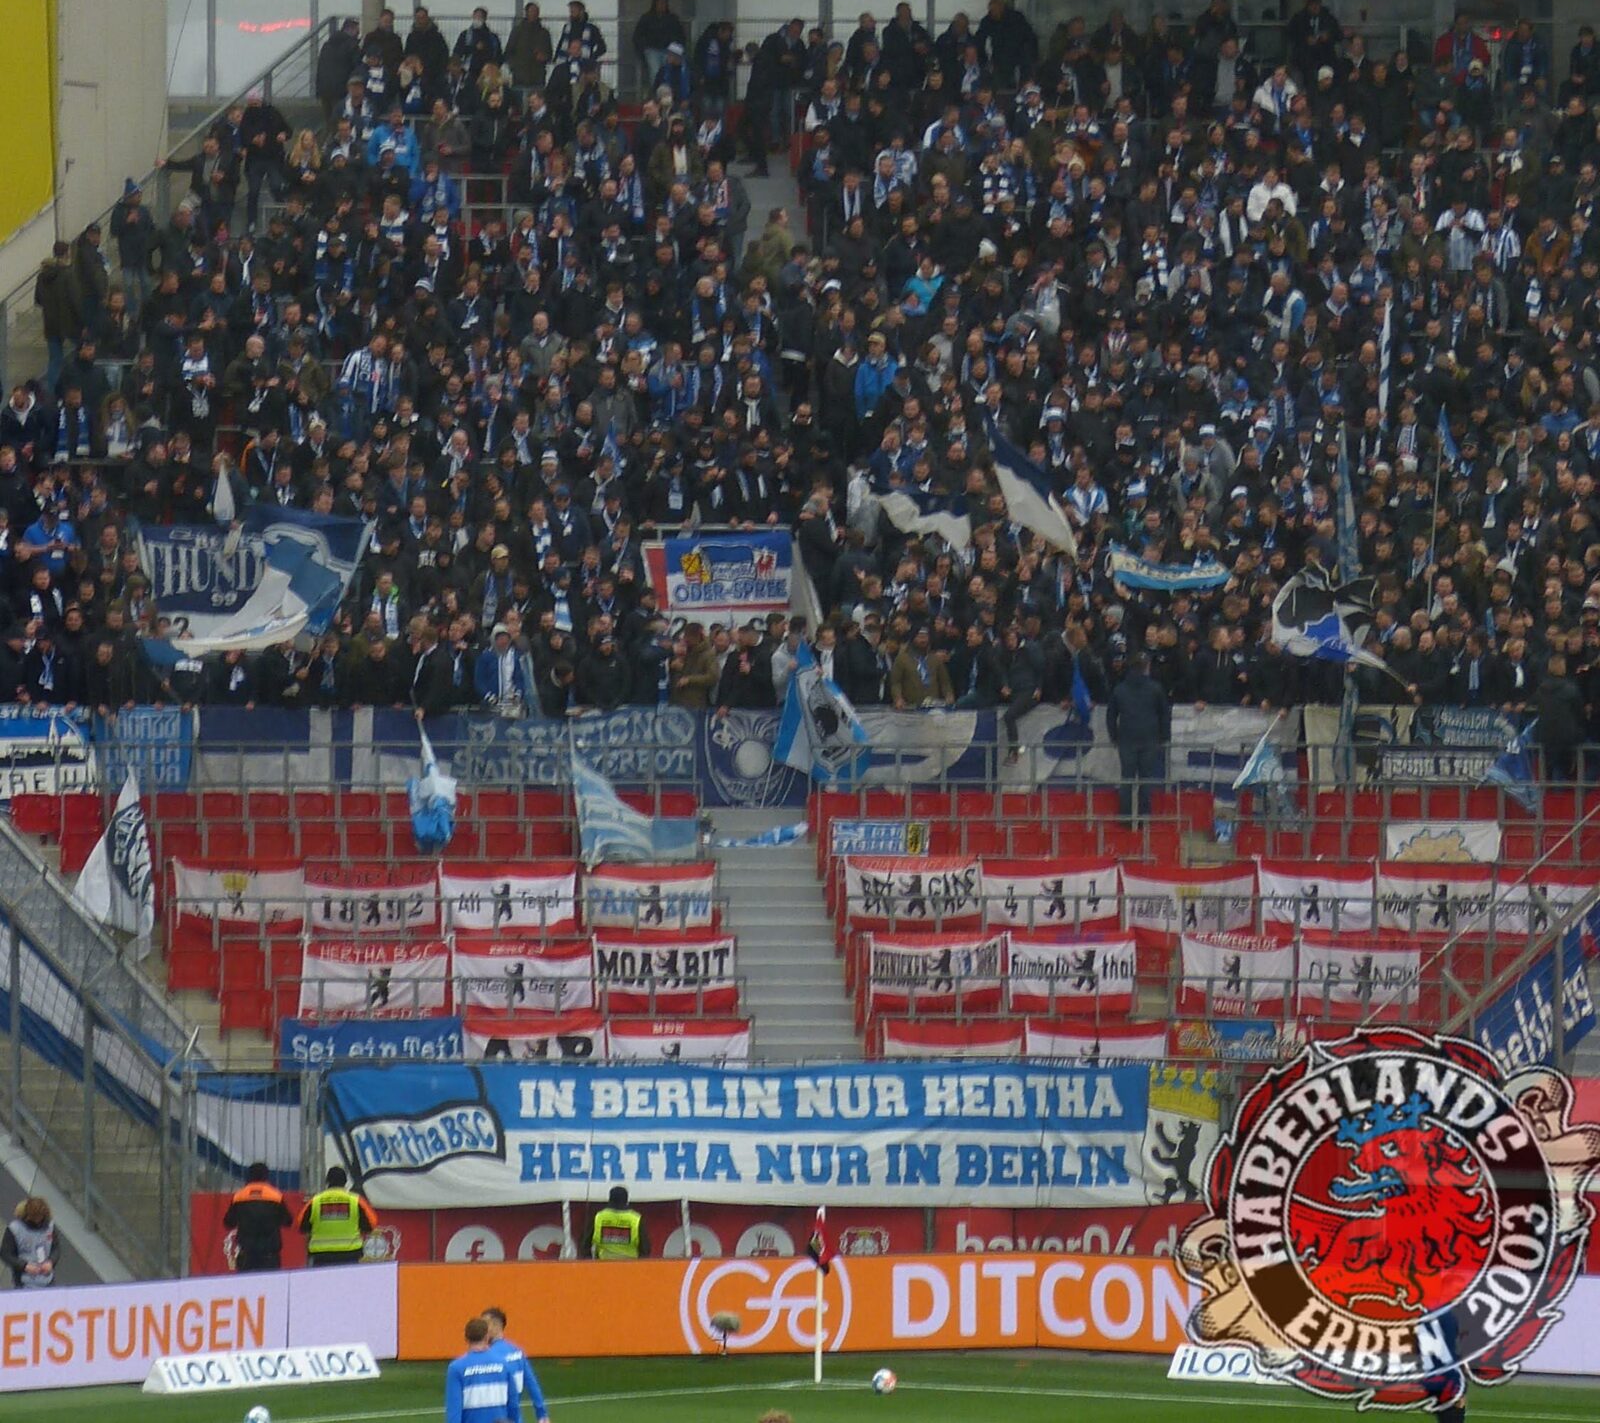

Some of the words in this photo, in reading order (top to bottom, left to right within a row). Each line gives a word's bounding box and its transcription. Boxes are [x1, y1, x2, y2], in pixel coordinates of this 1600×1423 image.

[675, 579, 788, 603] ODER-SPREE
[518, 1079, 577, 1119] IN
[591, 1078, 780, 1120] BERLIN
[796, 1076, 909, 1119] NUR
[922, 1075, 1123, 1119] HERTHA
[356, 1121, 446, 1170] Hertha
[444, 1110, 498, 1153] BSC
[519, 1143, 742, 1183] HERTHA
[755, 1143, 871, 1186] NUR
[886, 1144, 941, 1186] IN
[955, 1145, 1131, 1187] BERLIN
[2, 1295, 266, 1366] EISTUNGEN
[167, 1359, 233, 1385] iLOQ
[238, 1355, 302, 1381] iLOQ
[308, 1351, 372, 1375] iLOQ
[1178, 1351, 1253, 1377] iLOQ
